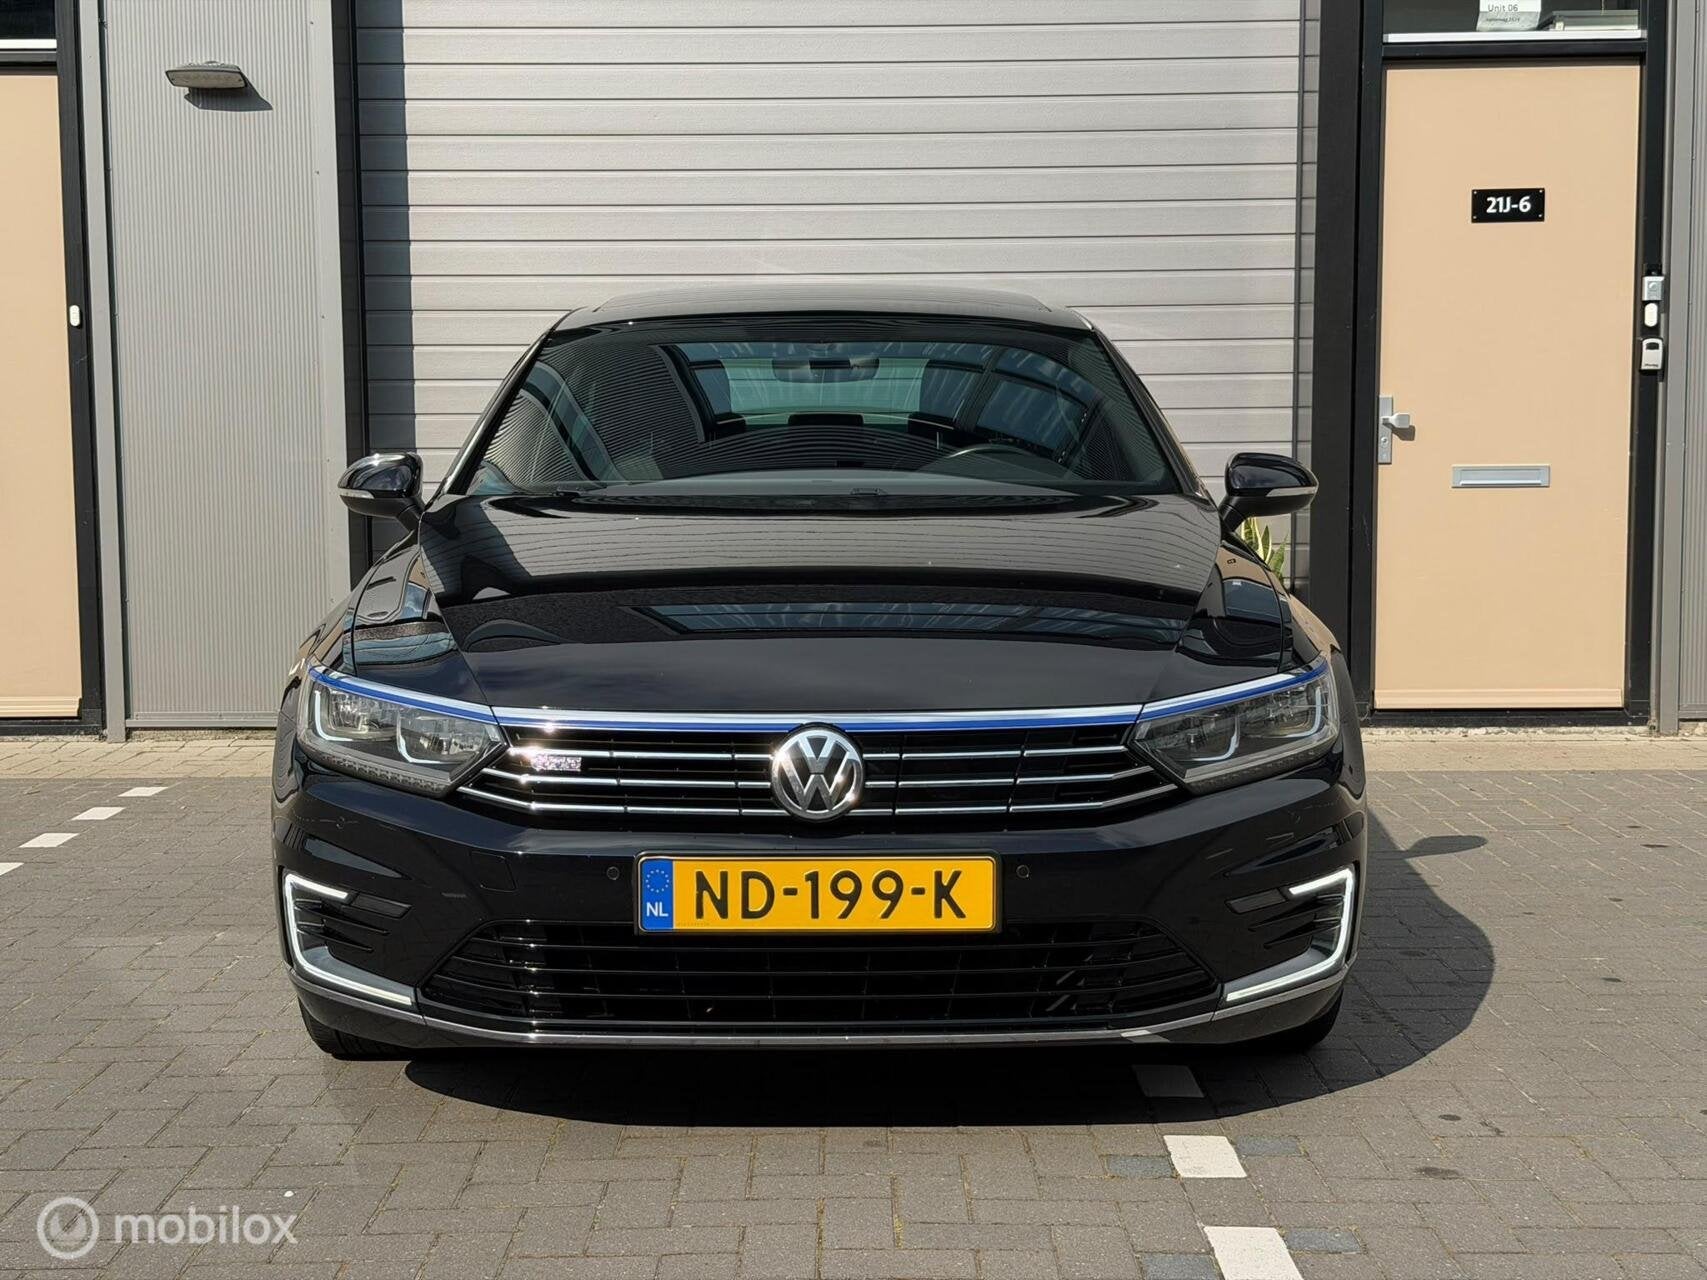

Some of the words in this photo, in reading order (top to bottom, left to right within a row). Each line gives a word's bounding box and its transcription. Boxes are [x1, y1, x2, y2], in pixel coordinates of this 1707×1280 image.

[1487, 4, 1505, 12] Unit
[1508, 4, 1518, 12] 06
[1486, 196, 1531, 213] 21J-6
[695, 869, 966, 919] ND-199-K
[646, 902, 669, 917] NL
